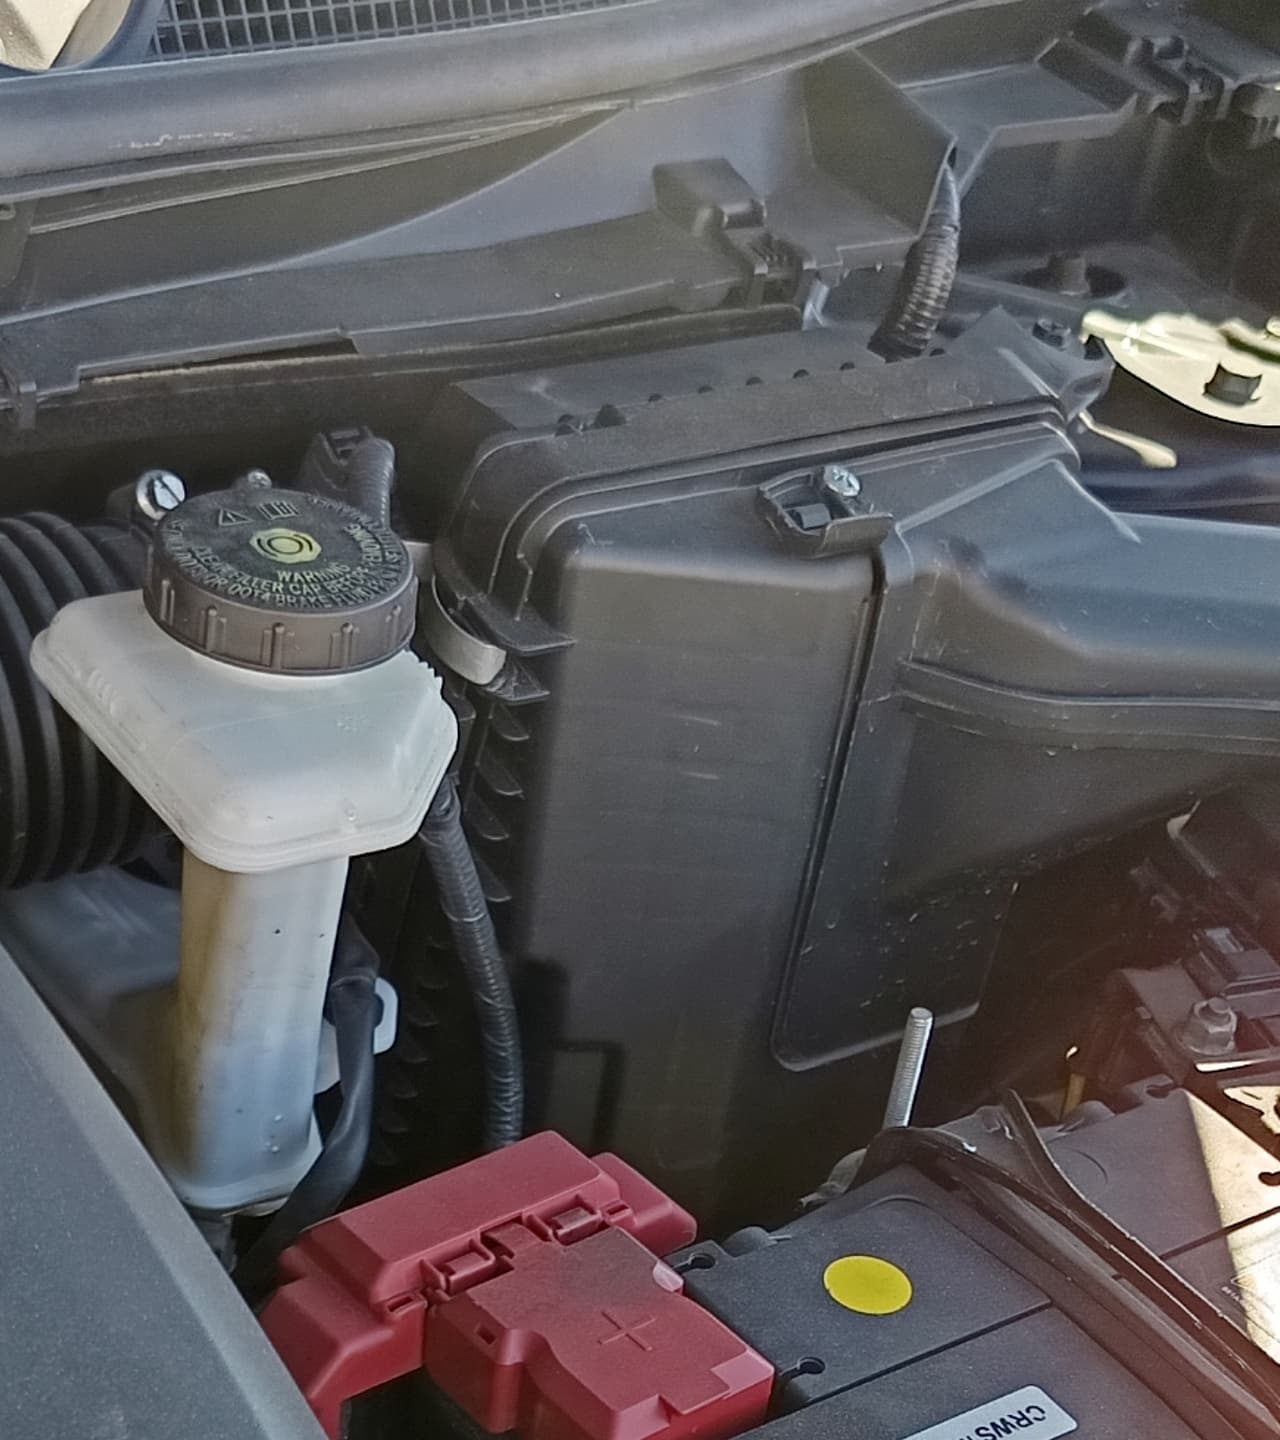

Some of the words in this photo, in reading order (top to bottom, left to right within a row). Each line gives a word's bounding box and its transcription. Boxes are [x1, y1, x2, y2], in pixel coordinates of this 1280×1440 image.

[232, 571, 284, 593] FILLER
[289, 583, 321, 595] CAP
[277, 562, 350, 582] WARNING
